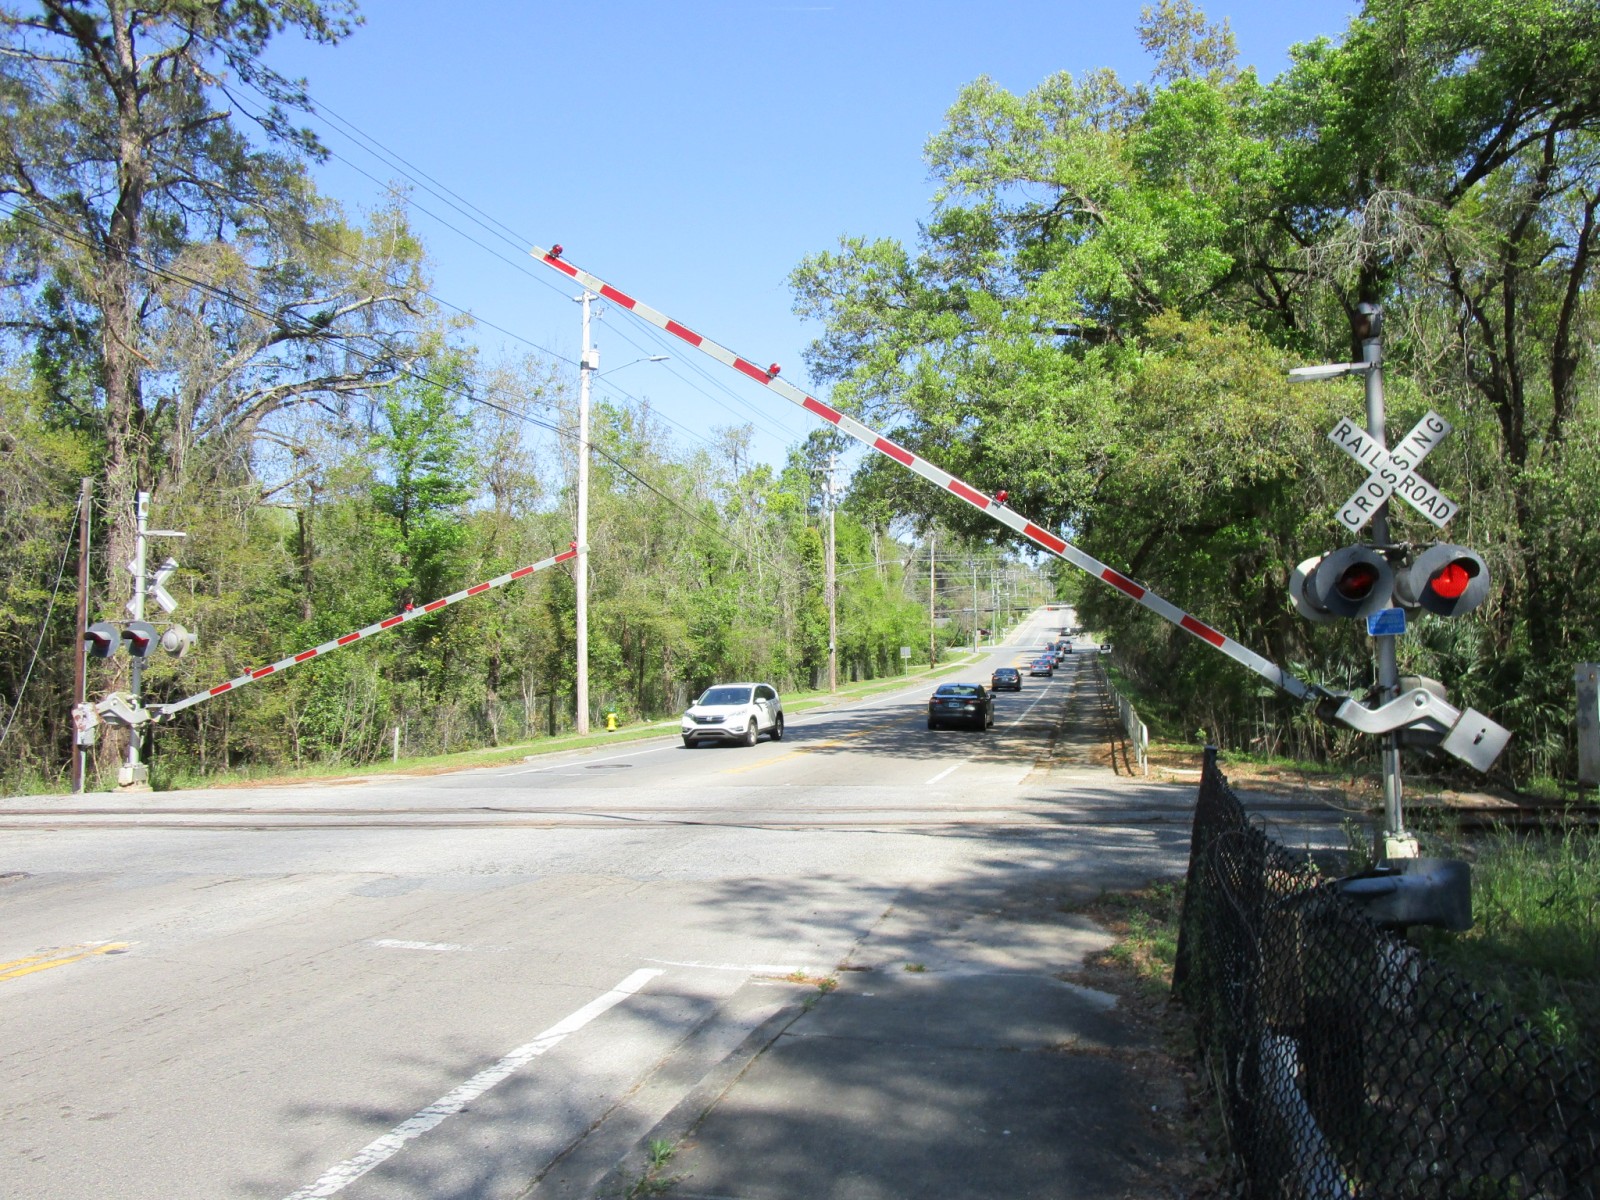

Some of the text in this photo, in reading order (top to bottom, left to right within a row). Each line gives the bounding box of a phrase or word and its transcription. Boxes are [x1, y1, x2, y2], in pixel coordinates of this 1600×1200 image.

[1334, 423, 1450, 520] RAIL ROAD
[1343, 418, 1444, 525] CROSSING
